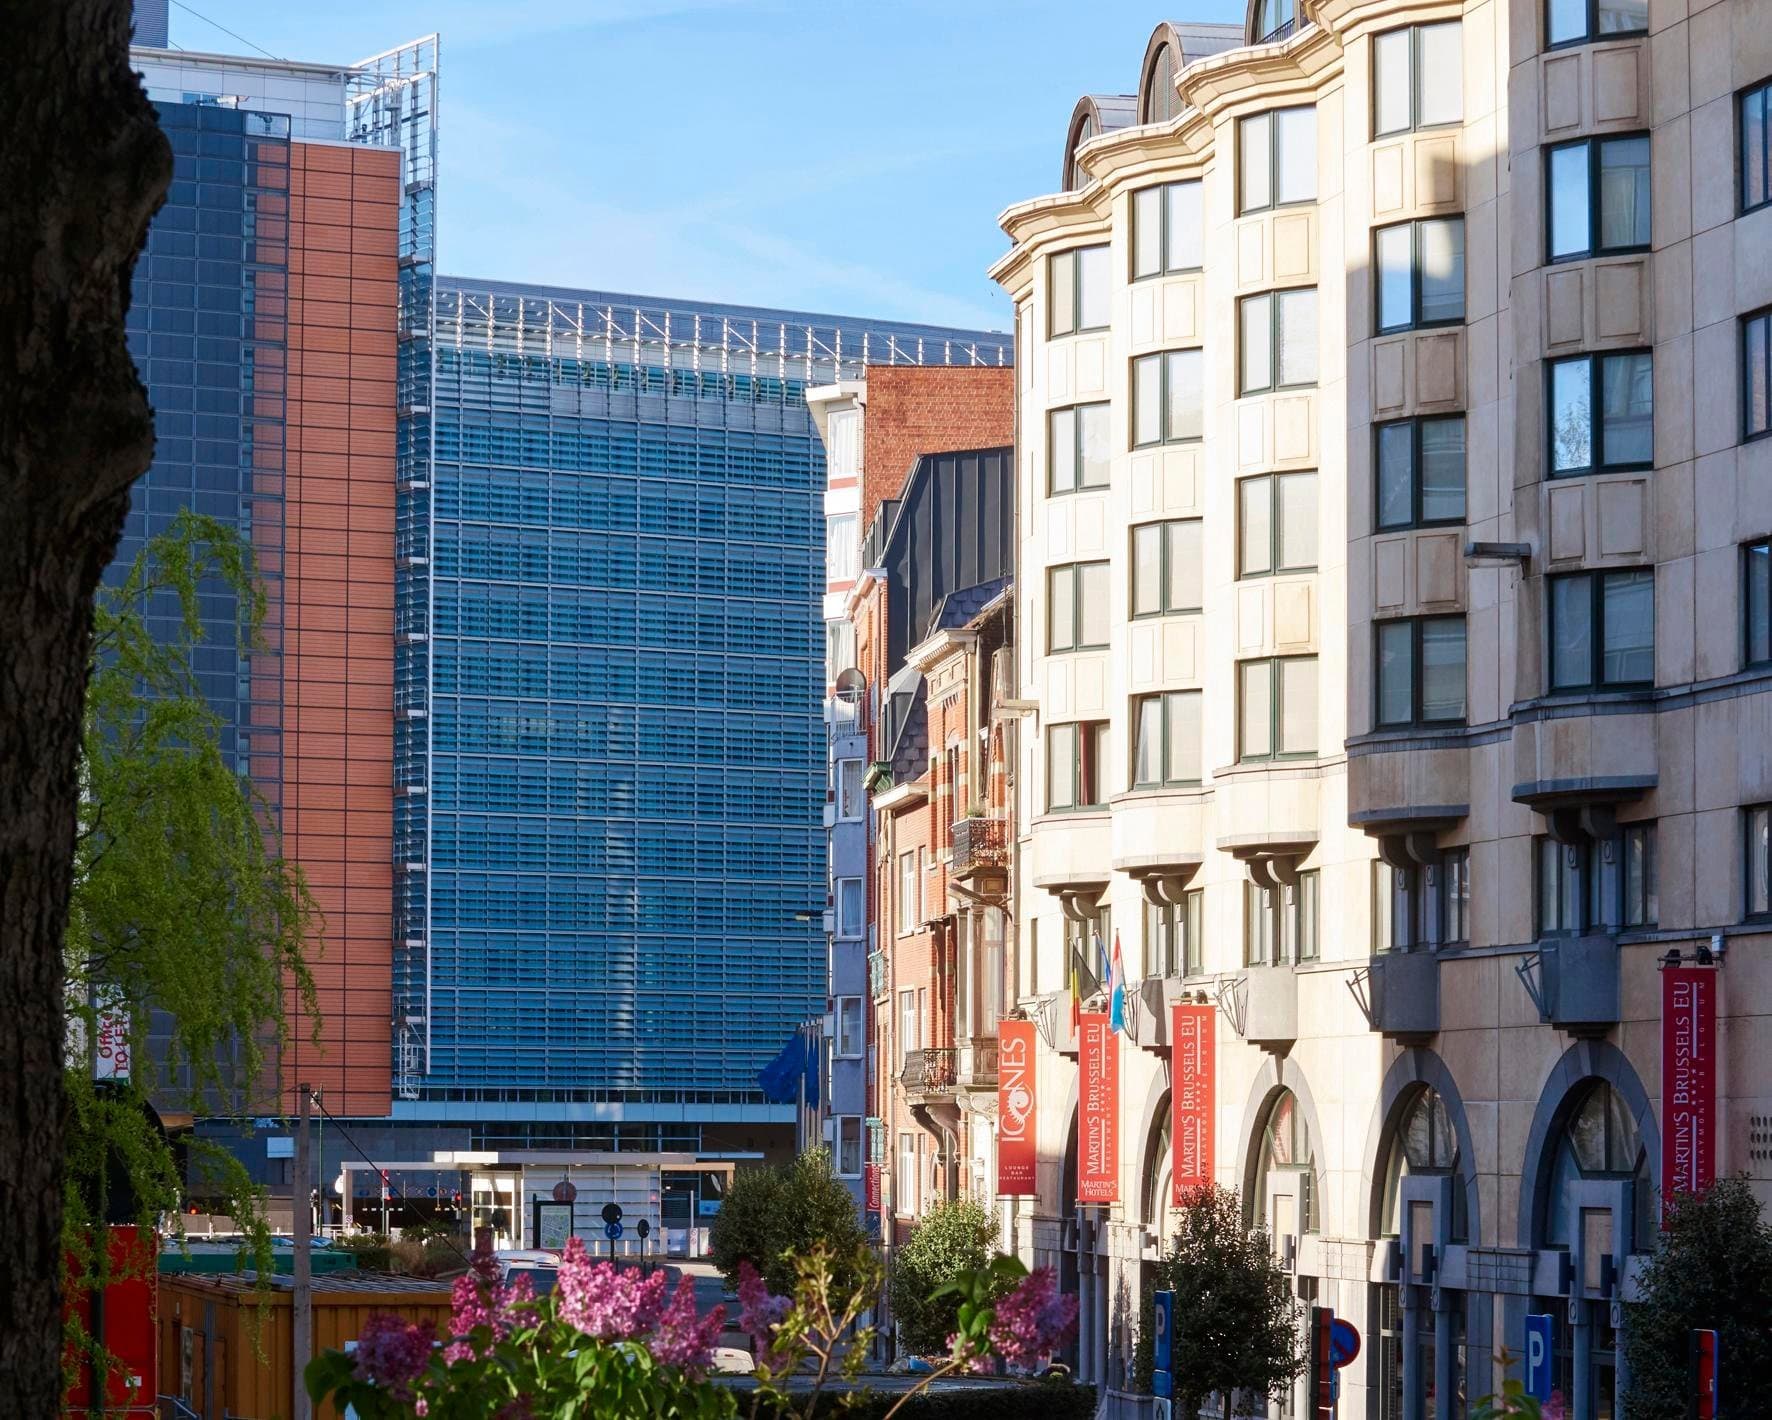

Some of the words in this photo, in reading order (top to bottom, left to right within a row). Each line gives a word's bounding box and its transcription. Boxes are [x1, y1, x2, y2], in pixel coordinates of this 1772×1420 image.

[1673, 982, 1689, 1008] EU
[1087, 1023, 1100, 1043] EU
[1181, 1015, 1195, 1036] EU
[1087, 1048, 1100, 1112] BRUSSELS
[1181, 1041, 1195, 1110] BRUSSELS
[1673, 1016, 1689, 1105] BRUSSELS
[1087, 1116, 1100, 1175] MARTIN'S
[1181, 1115, 1195, 1178] MARTIN'S
[1672, 1112, 1690, 1192] MARTIN'S
[869, 1166, 880, 1208] Connections
[1081, 1180, 1117, 1189] MARTIN'S
[1085, 1188, 1114, 1197] HOTELS
[1156, 1304, 1166, 1357] P
[1529, 1331, 1544, 1393] P
